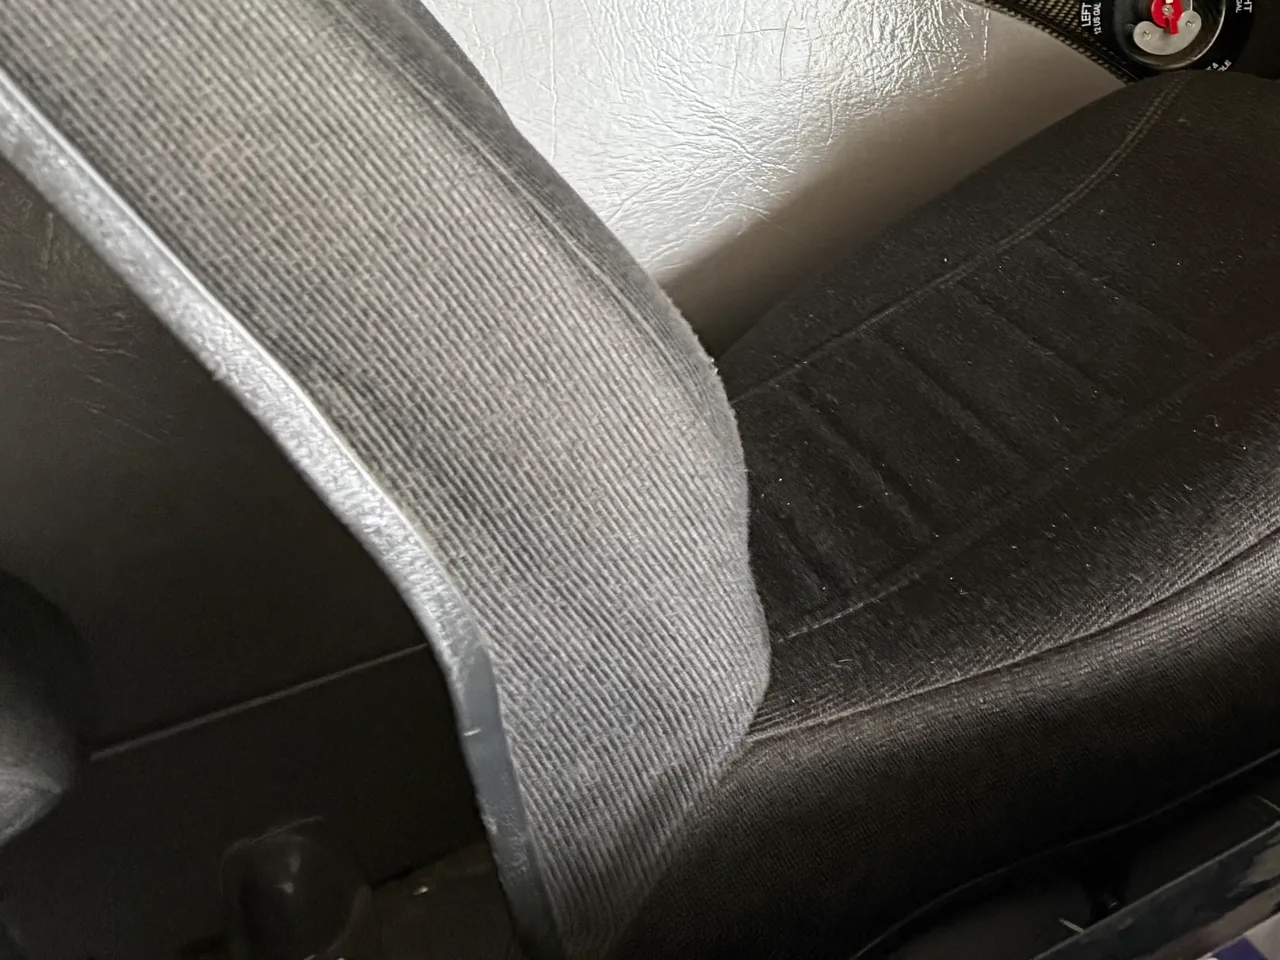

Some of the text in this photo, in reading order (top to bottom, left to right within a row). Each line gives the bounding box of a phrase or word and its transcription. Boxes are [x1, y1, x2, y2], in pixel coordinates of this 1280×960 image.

[1081, 2, 1092, 26] LEFT
[1094, 2, 1102, 15] GAL
[1094, 16, 1100, 26] US
